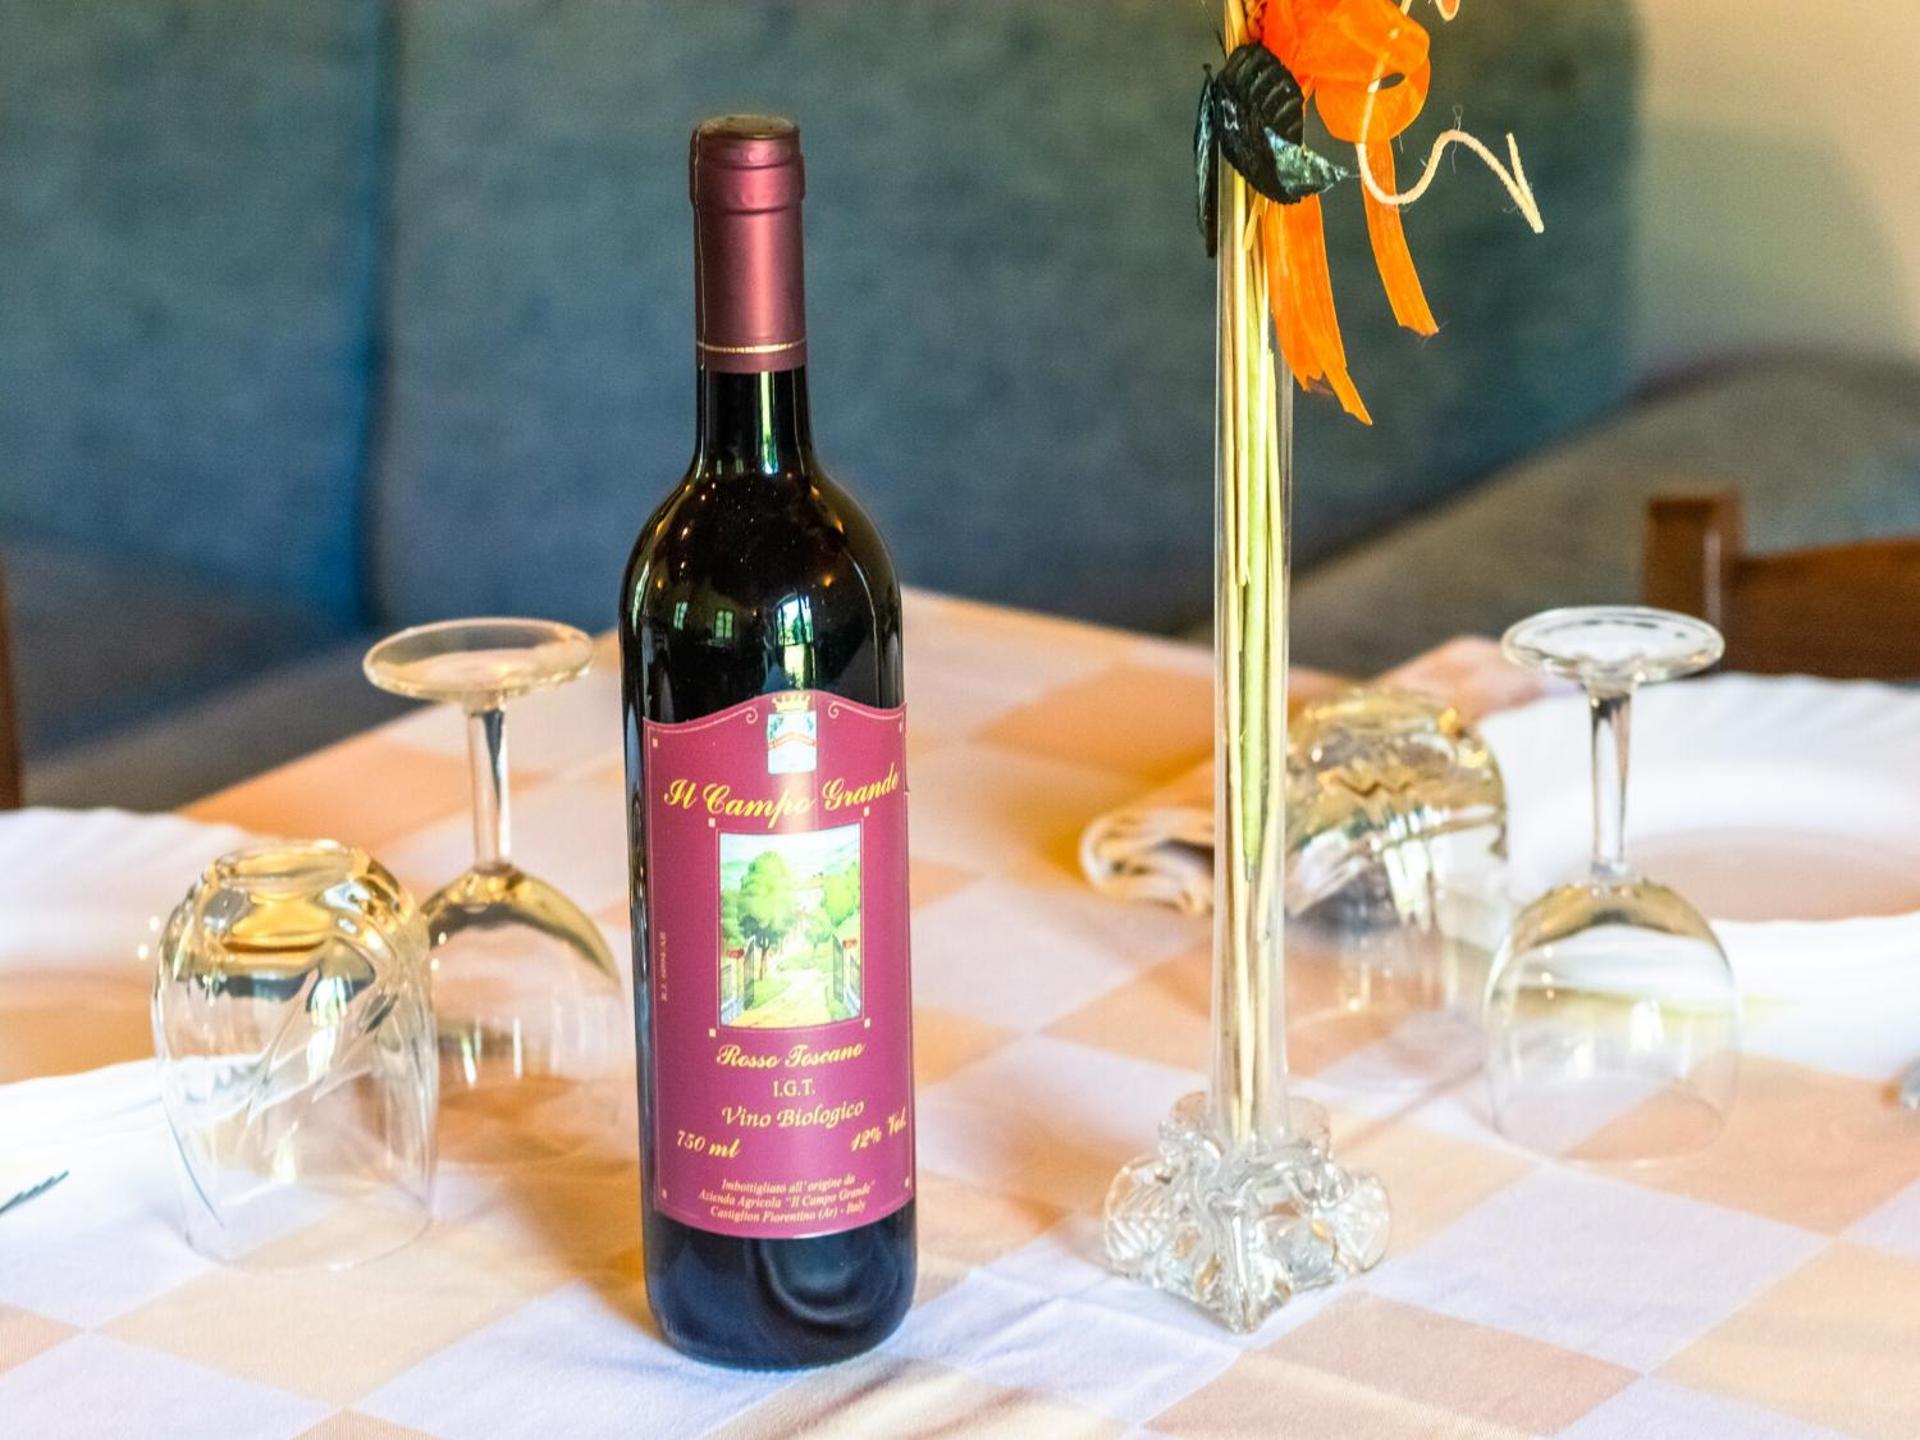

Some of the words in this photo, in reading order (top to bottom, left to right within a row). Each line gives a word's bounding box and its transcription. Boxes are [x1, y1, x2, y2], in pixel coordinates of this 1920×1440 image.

[664, 778, 699, 810] Il
[702, 783, 818, 829] Campo
[822, 761, 900, 811] Grande
[716, 1044, 782, 1069] Rosso
[785, 1042, 867, 1068] Toscano
[772, 1078, 815, 1098] I.G.T.
[721, 1105, 772, 1128] Vino
[776, 1100, 865, 1129] Biologico
[677, 1130, 706, 1151] 750
[708, 1138, 741, 1159] ml
[850, 1127, 882, 1152] 12%
[737, 1195, 781, 1209] Agricola
[802, 1194, 837, 1207] Campo
